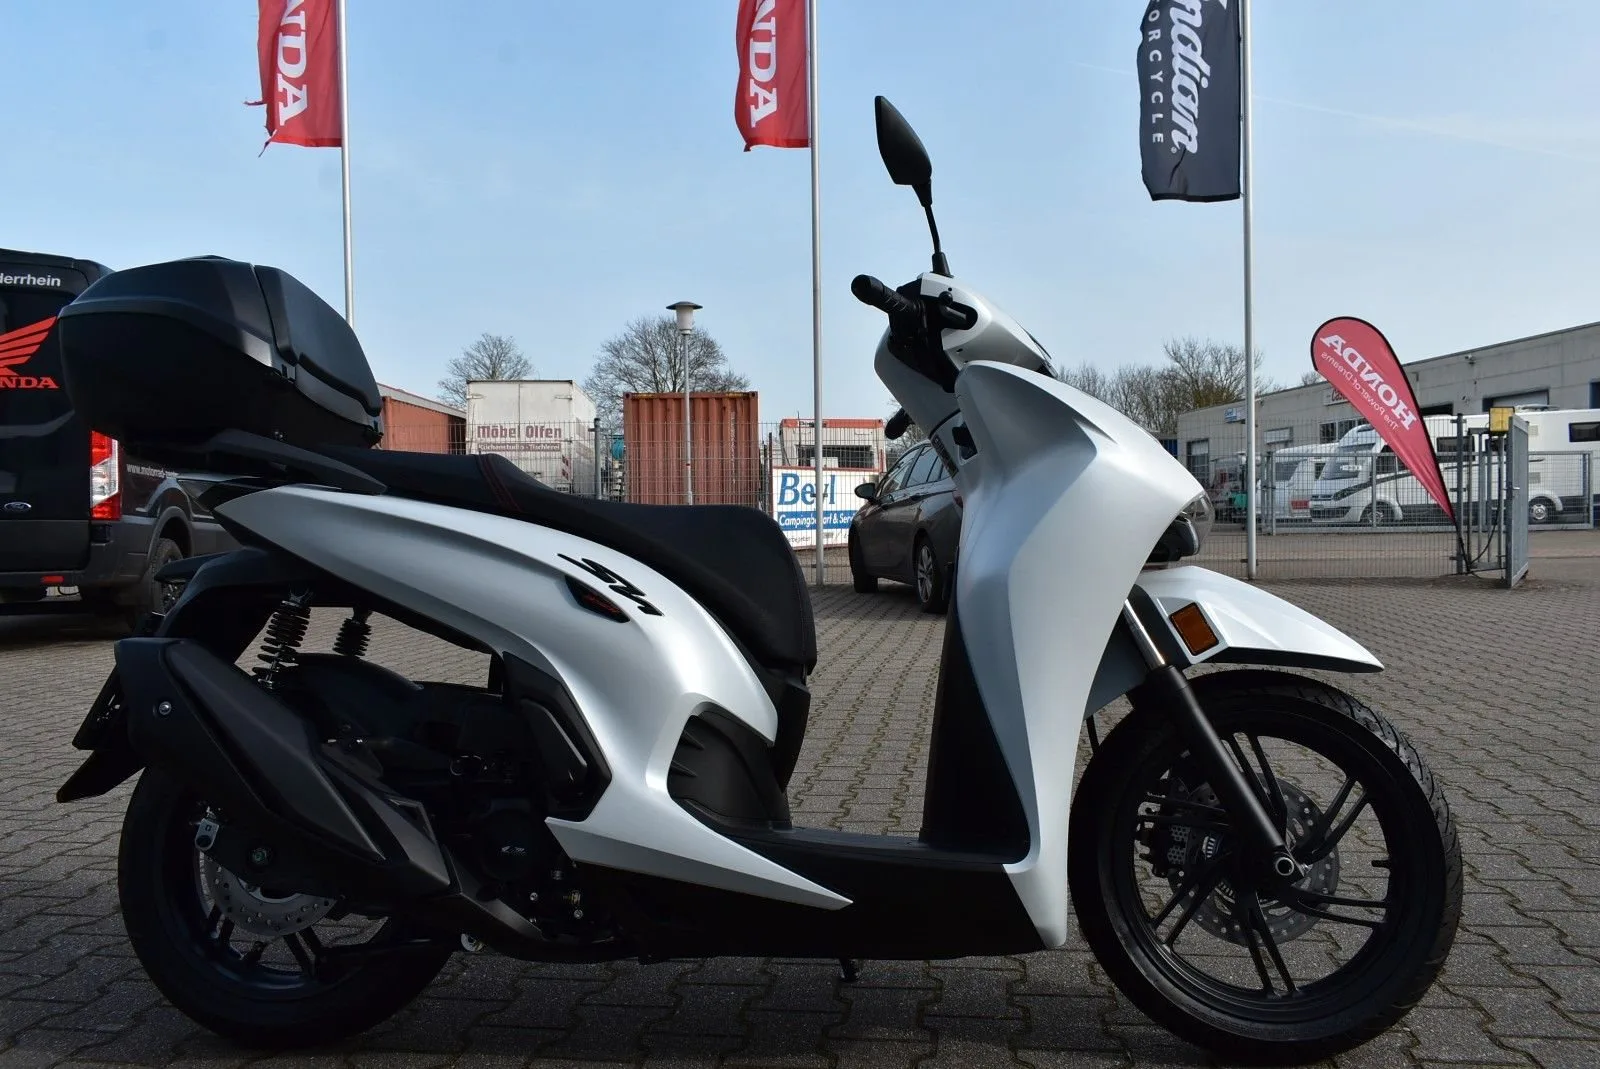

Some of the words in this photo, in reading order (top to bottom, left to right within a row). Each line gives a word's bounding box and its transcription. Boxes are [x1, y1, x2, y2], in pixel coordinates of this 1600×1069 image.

[1147, 0, 1164, 144] ORCYCLE
[477, 425, 520, 438] Möbel
[525, 425, 562, 438] Olfen
[779, 514, 832, 529] Campingbarf
[833, 513, 838, 524] &
